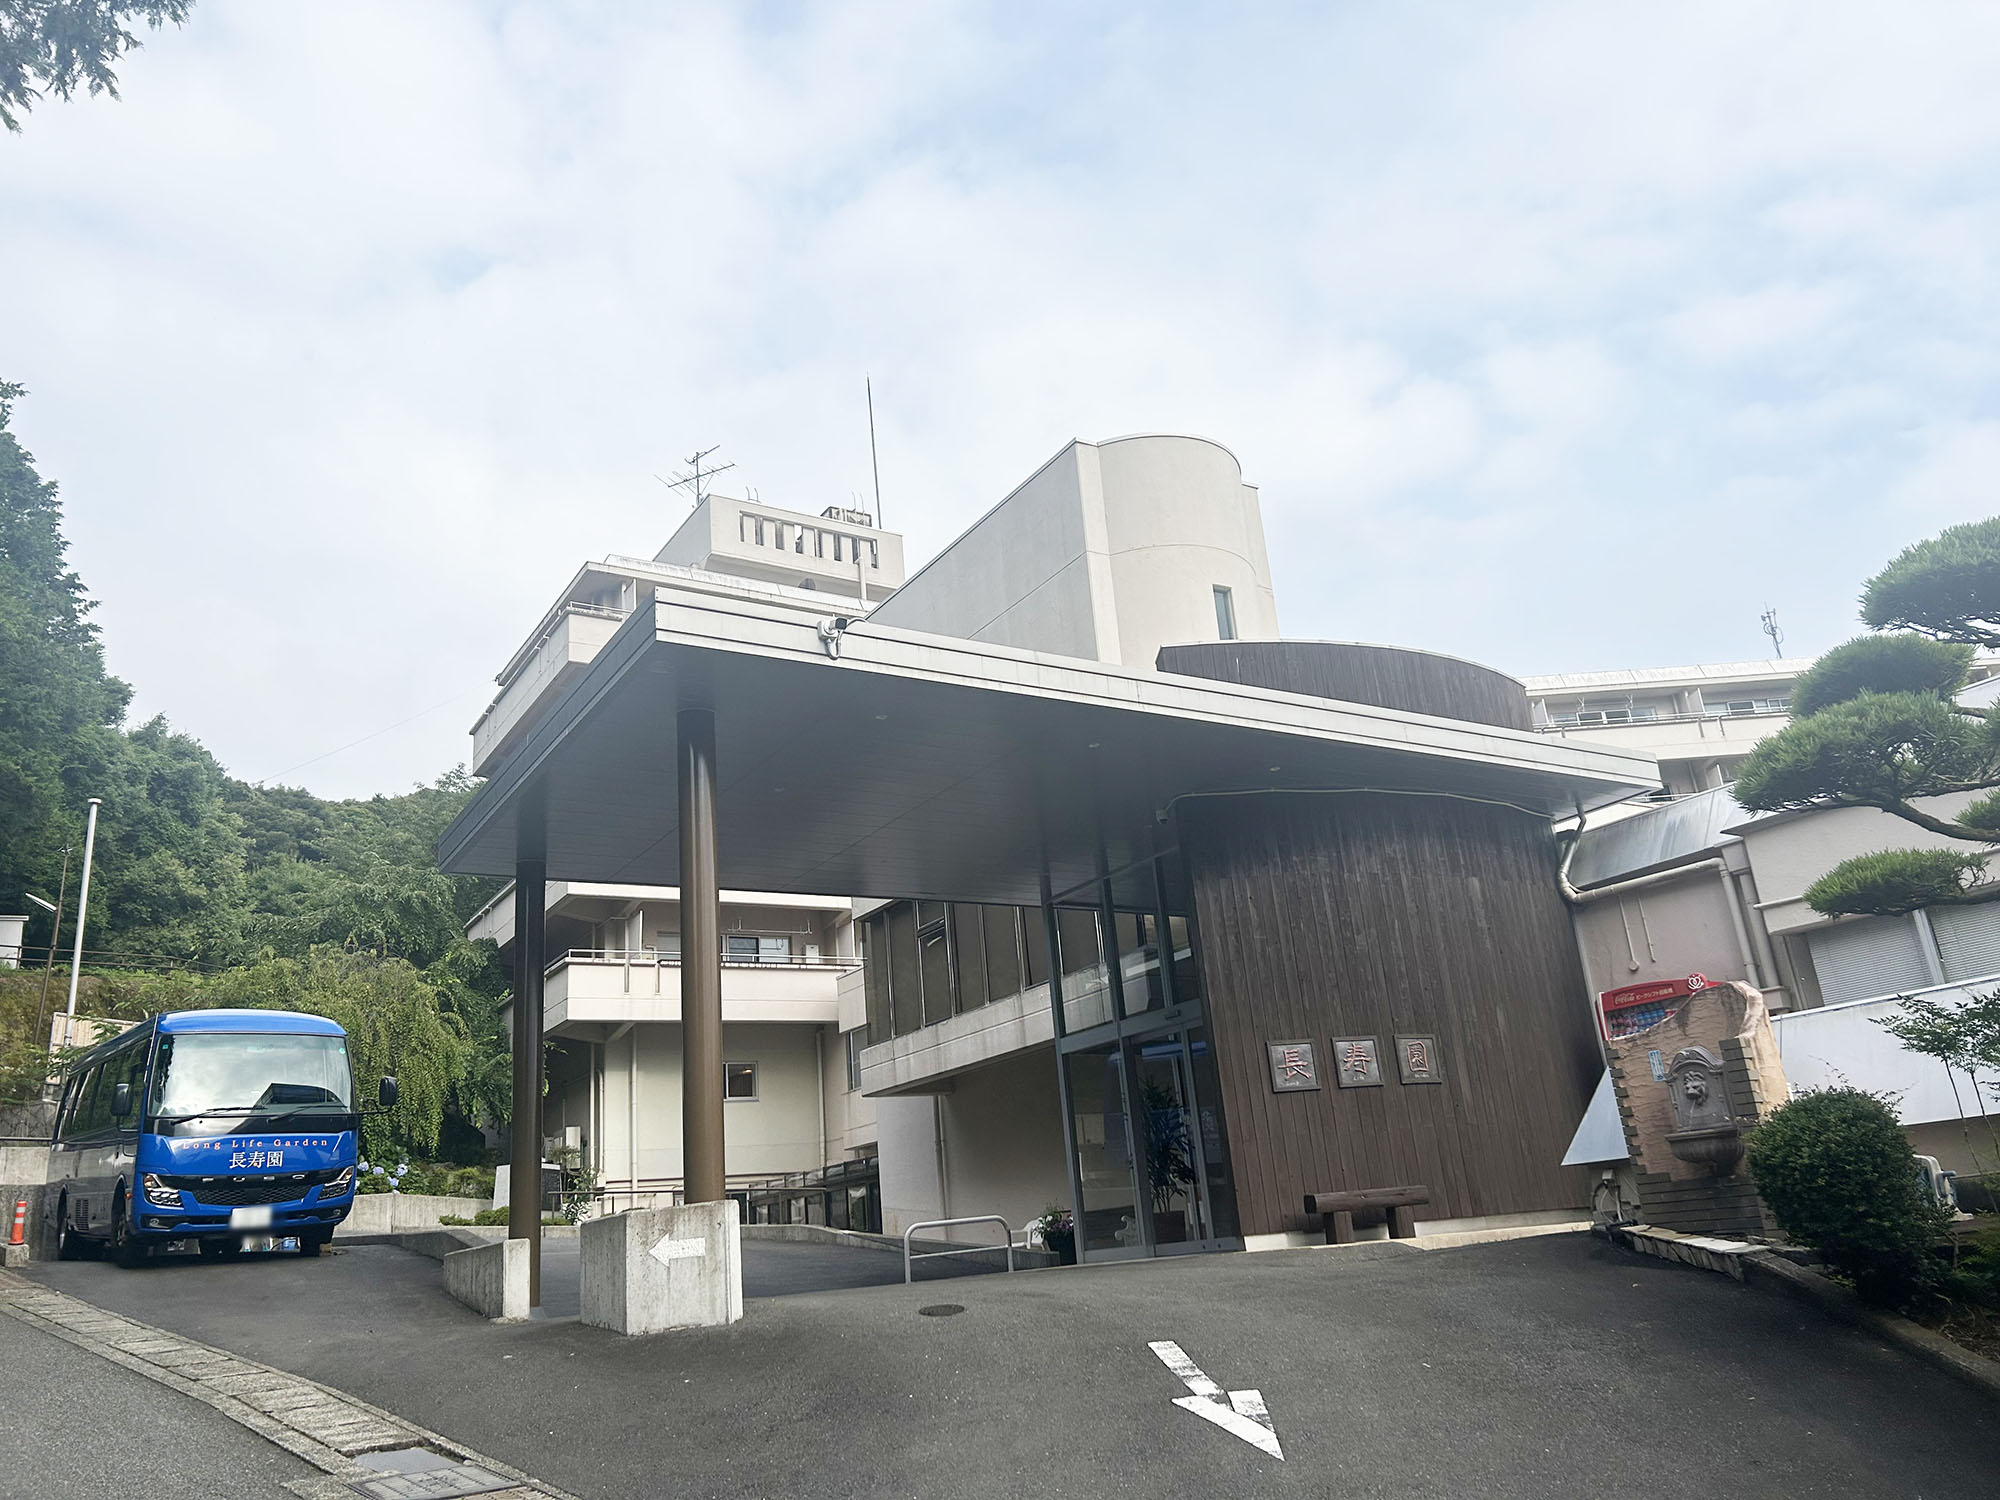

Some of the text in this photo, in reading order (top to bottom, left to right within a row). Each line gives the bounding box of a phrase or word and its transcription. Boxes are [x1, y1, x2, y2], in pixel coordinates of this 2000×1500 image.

[183, 1139, 328, 1150] Long Life Garden
[229, 1151, 283, 1169] 長寿園
